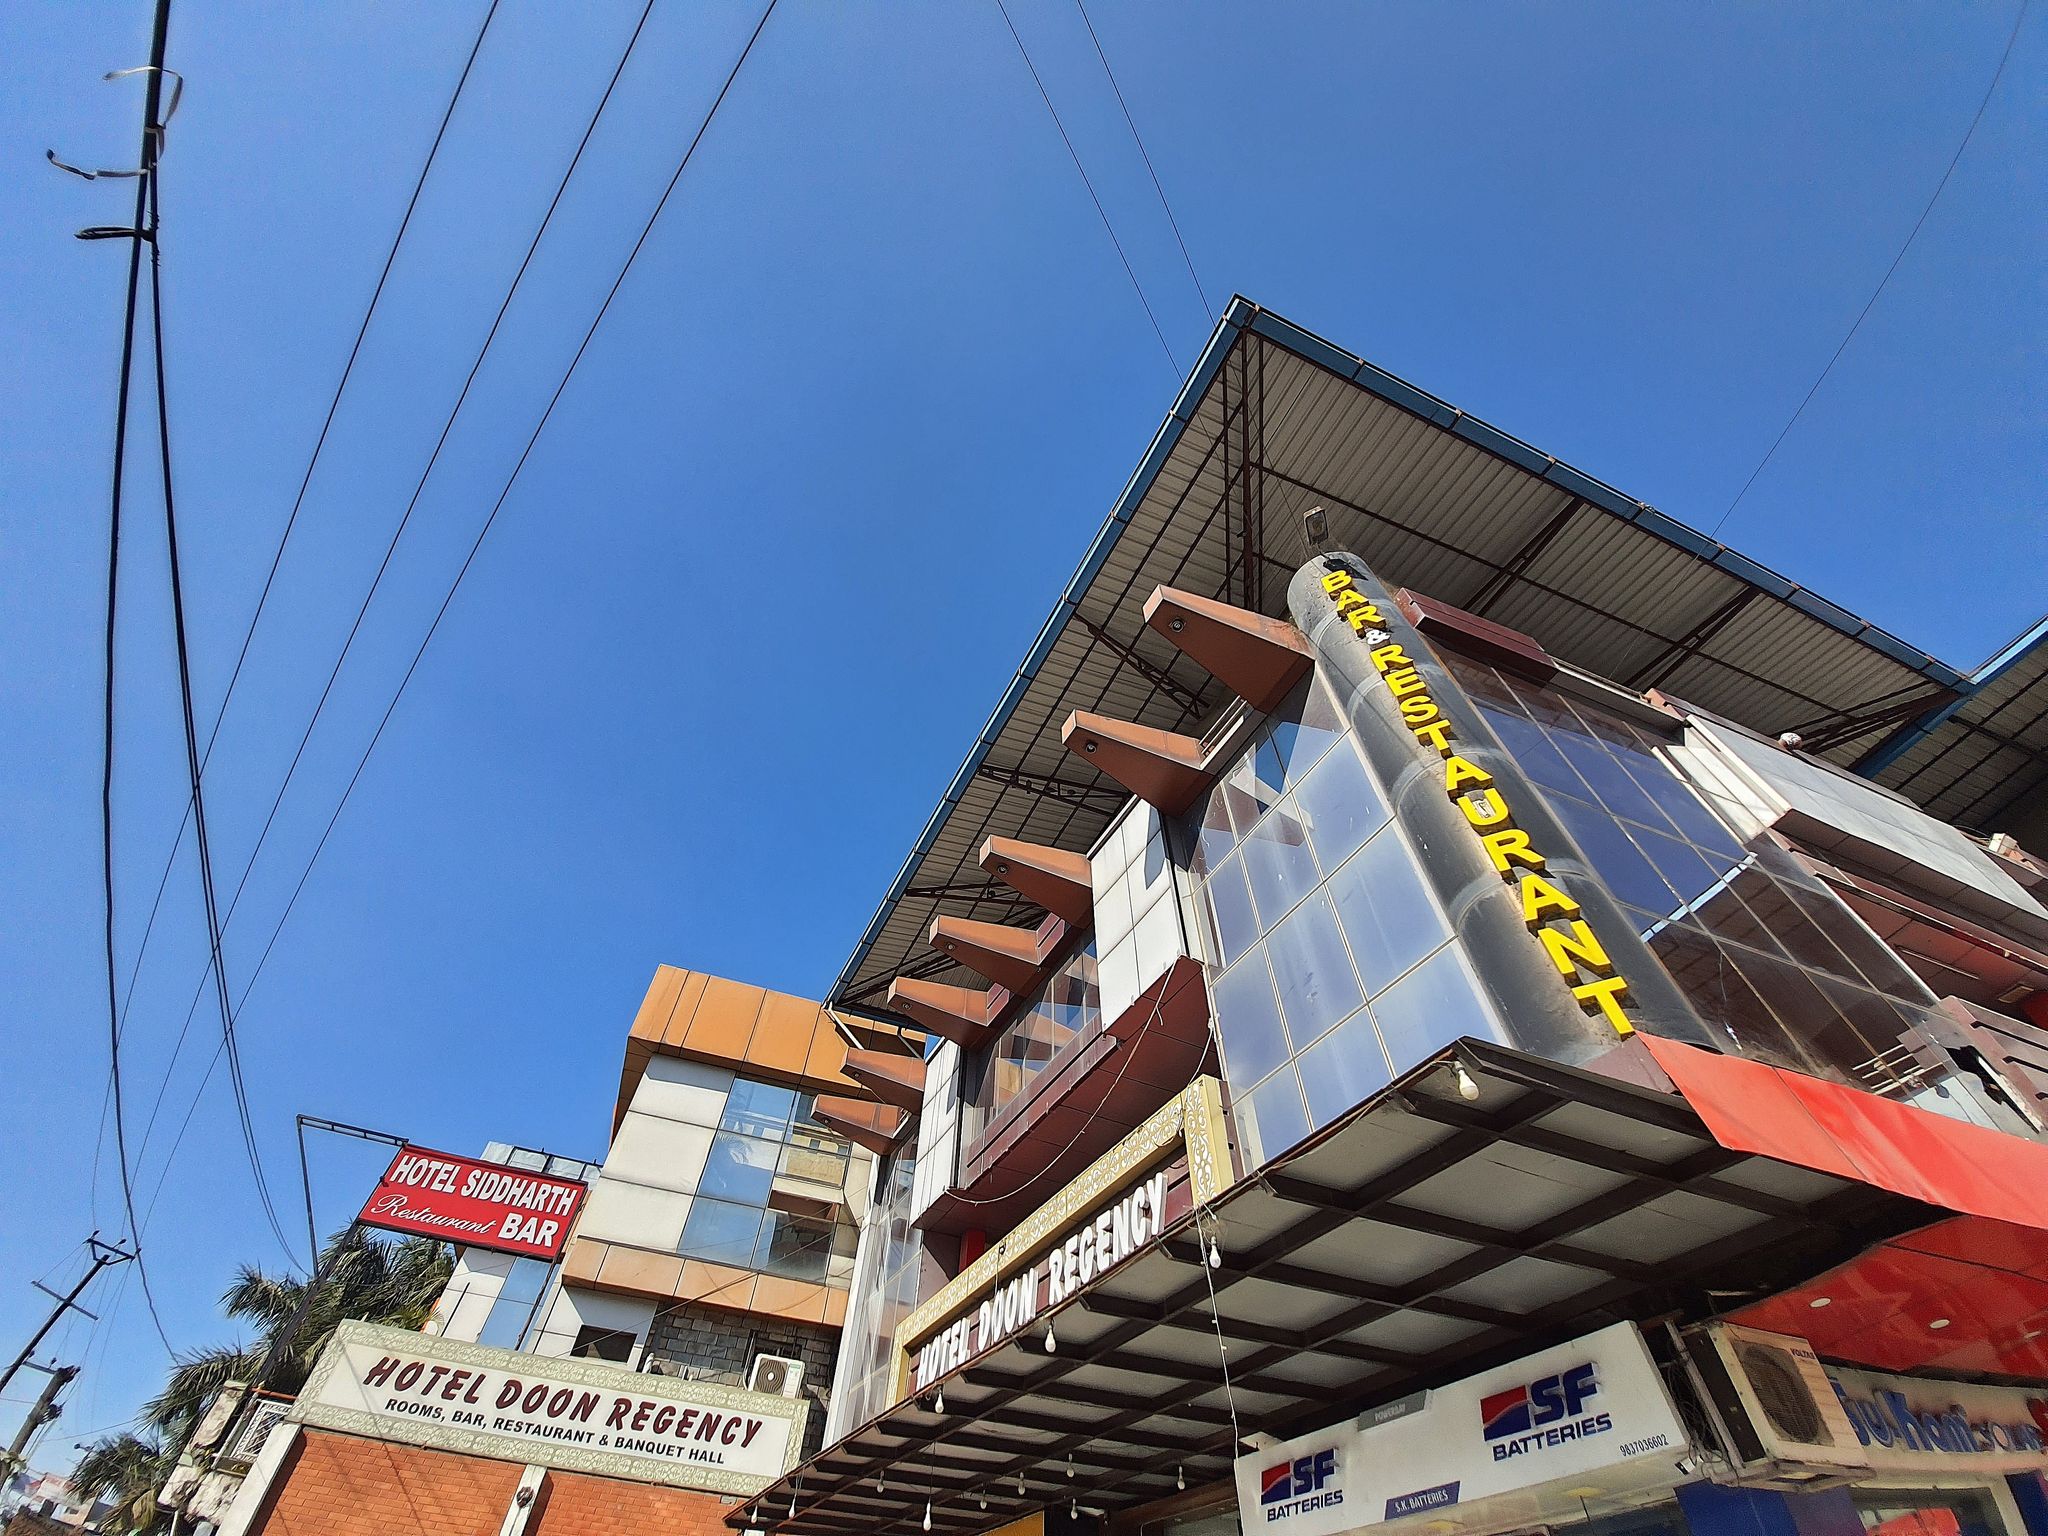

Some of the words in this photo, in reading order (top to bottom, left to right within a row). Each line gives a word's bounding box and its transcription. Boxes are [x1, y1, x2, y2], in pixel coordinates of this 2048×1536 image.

[1320, 570, 1386, 638] BAR
[1366, 628, 1391, 648] &
[1369, 644, 1636, 1036] RESTAURANT
[390, 1155, 461, 1194] HOTEL
[461, 1169, 578, 1217] SIDDHARTH
[370, 1194, 497, 1235] Restaurant
[498, 1212, 559, 1248] BAR
[915, 1317, 971, 1391] HOTEL
[978, 1267, 1039, 1352] DOON
[1049, 1172, 1169, 1306] REGENCY
[362, 1356, 487, 1404] HOTEL
[495, 1379, 600, 1423] DOON
[605, 1397, 763, 1449] REGENCY
[1530, 1362, 1598, 1426] SF
[385, 1398, 446, 1423] ROOMS,
[451, 1410, 487, 1430] BAR,
[492, 1417, 595, 1444] RESTAURANT
[599, 1434, 608, 1446] &
[614, 1436, 686, 1458] BANQUET
[688, 1448, 725, 1465] HALL
[1492, 1412, 1613, 1462] BATTERIES
[1619, 1433, 1669, 1457] 9837036602
[1293, 1448, 1337, 1496] SF
[1409, 1489, 1449, 1510] BATTERIES
[1267, 1489, 1344, 1522] BATTERIES
